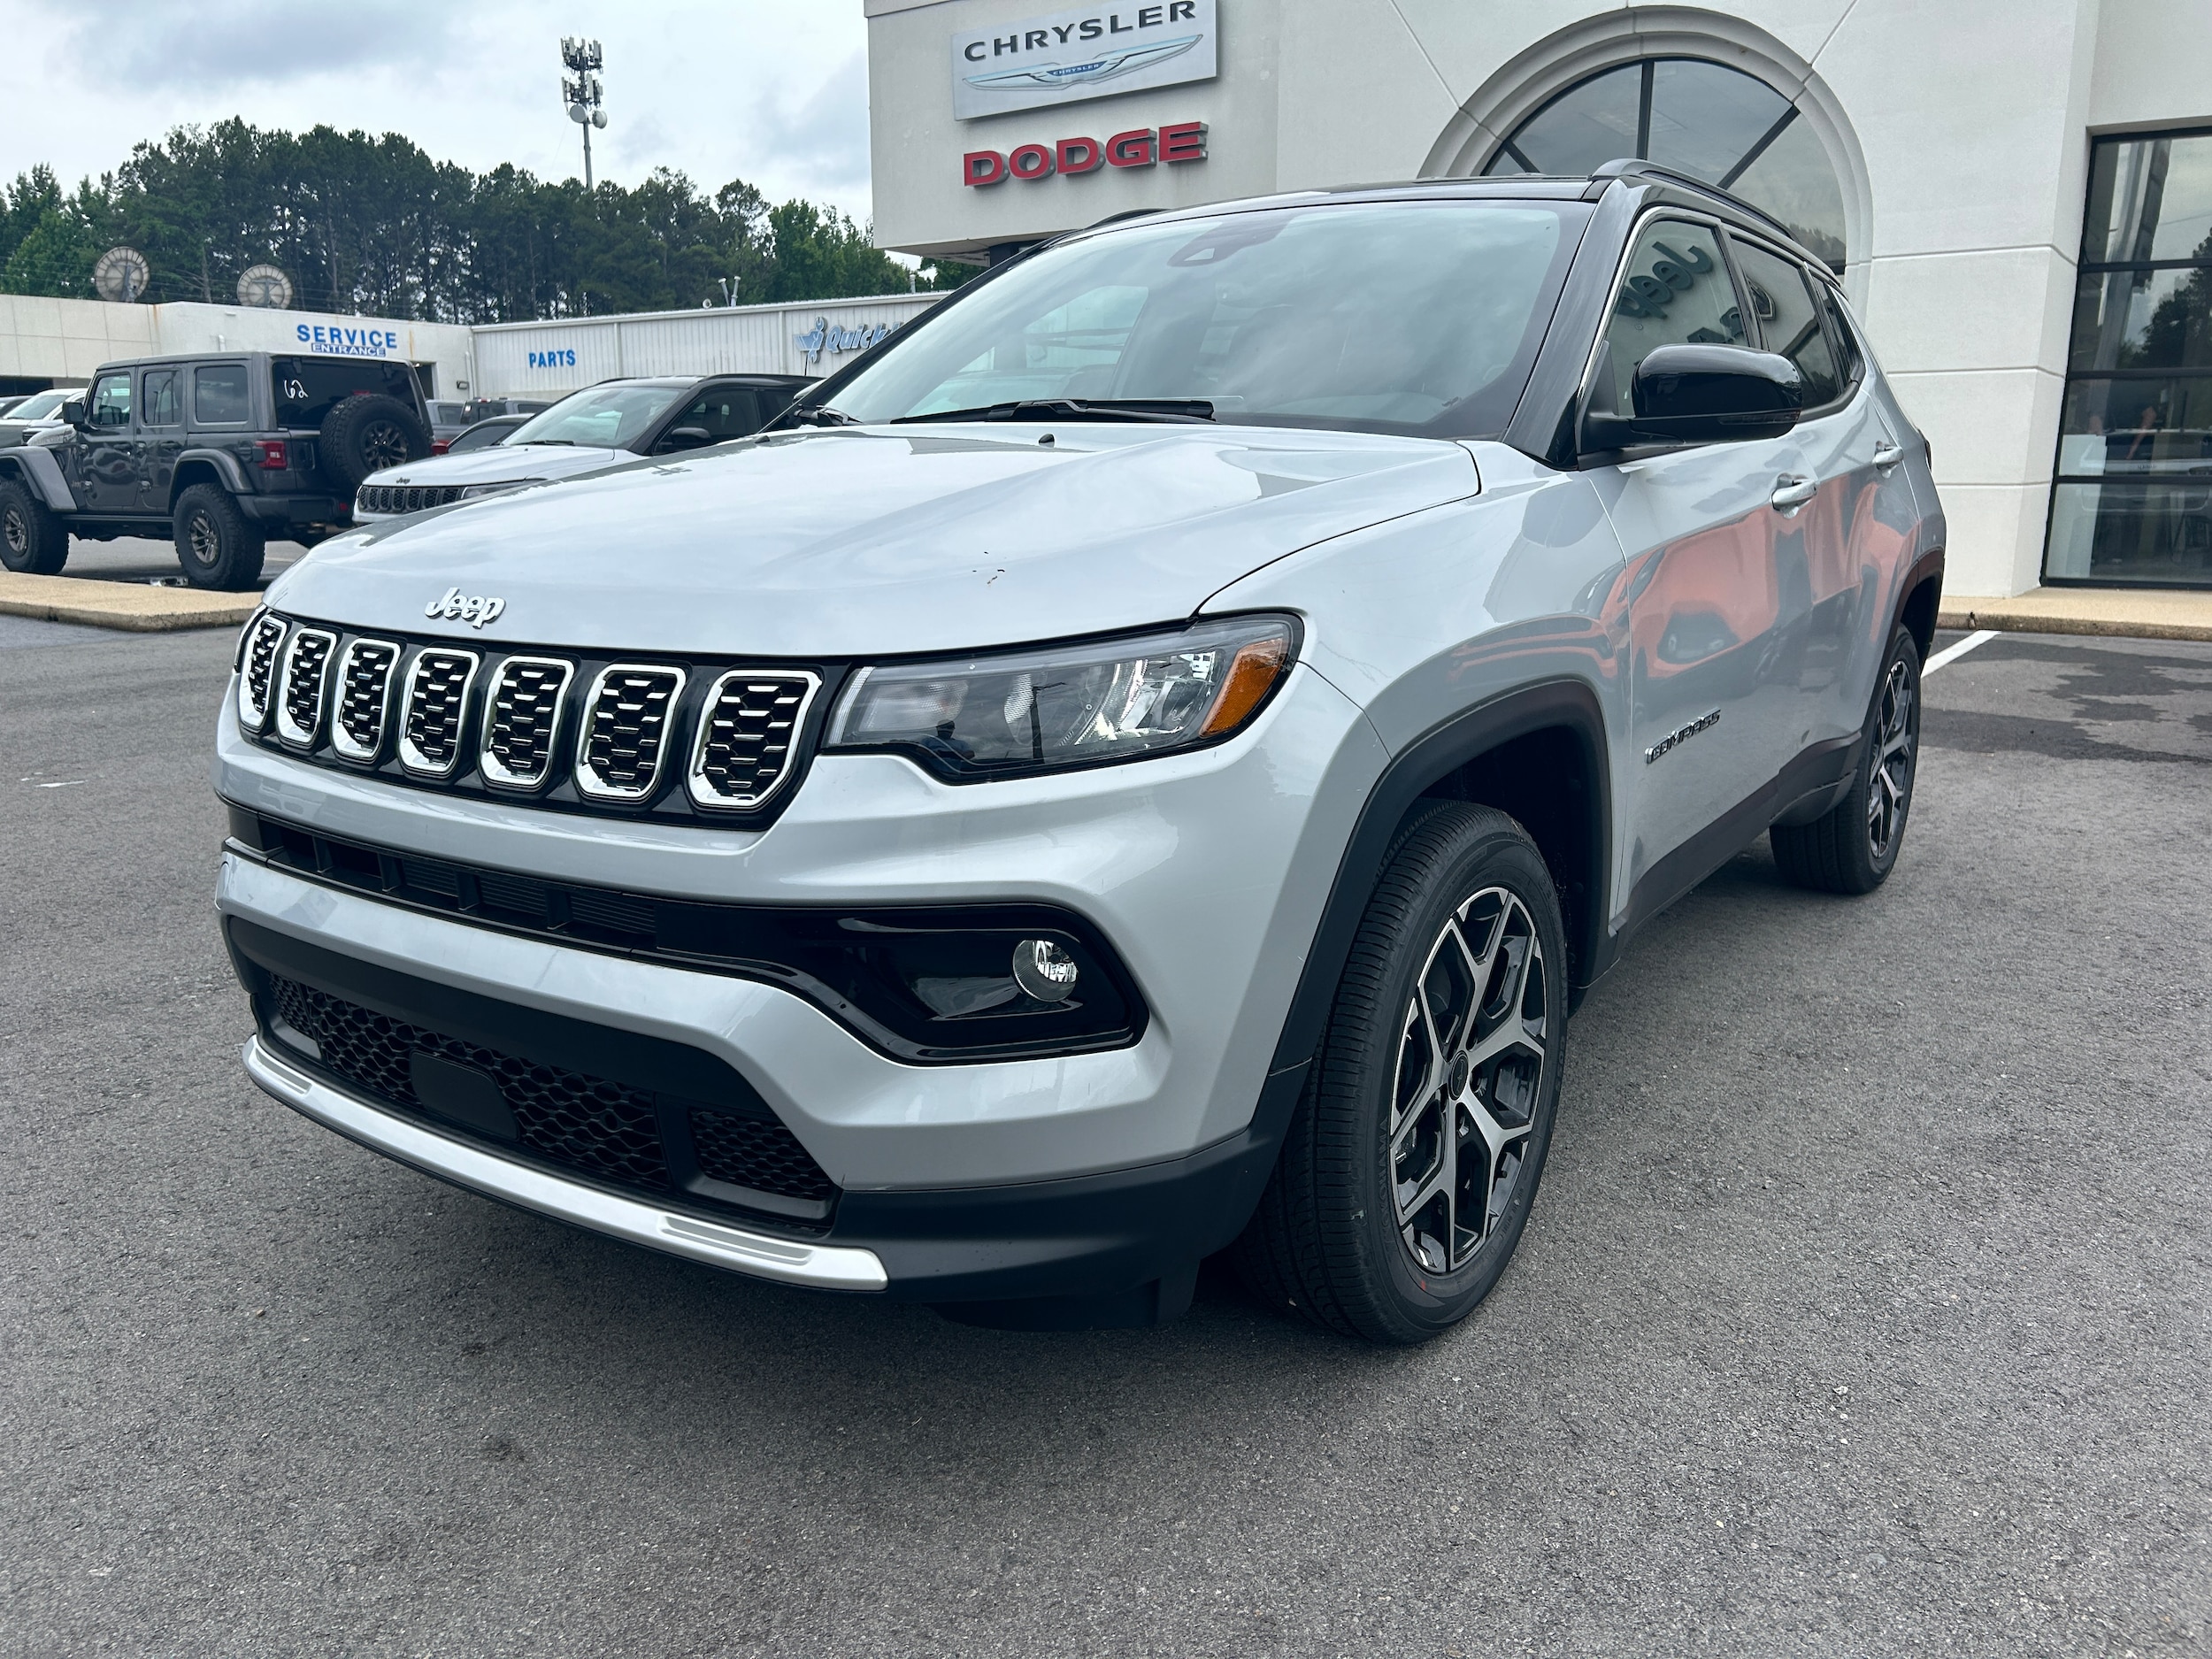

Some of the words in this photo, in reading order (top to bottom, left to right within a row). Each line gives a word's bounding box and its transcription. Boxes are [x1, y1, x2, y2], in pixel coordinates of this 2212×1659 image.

[964, 0, 1195, 62] CHRYSLER
[964, 121, 1207, 187] DODGE
[296, 324, 397, 349] SERVICE
[311, 343, 386, 357] ENTRANCE
[826, 323, 888, 353] Quick
[528, 349, 576, 368] PARTS
[284, 379, 309, 399] 62
[425, 587, 506, 629] Jeep
[1645, 708, 1721, 764] COMPASS
